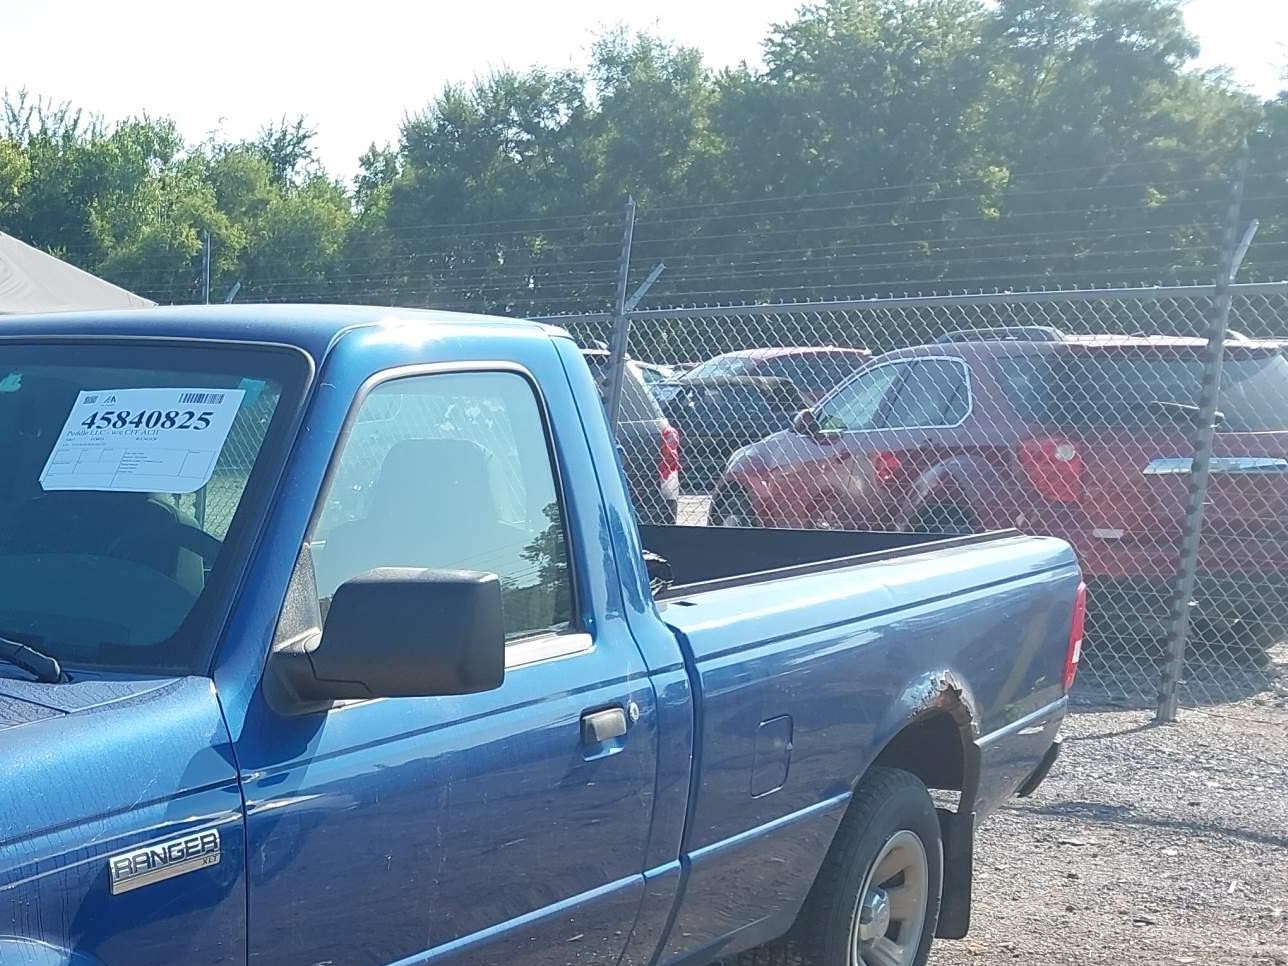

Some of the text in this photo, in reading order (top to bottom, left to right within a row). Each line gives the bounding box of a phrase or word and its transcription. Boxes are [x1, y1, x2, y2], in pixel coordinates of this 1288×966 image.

[81, 409, 215, 431] 45840825
[113, 832, 218, 879] RANGER
[202, 855, 217, 866] XLT
